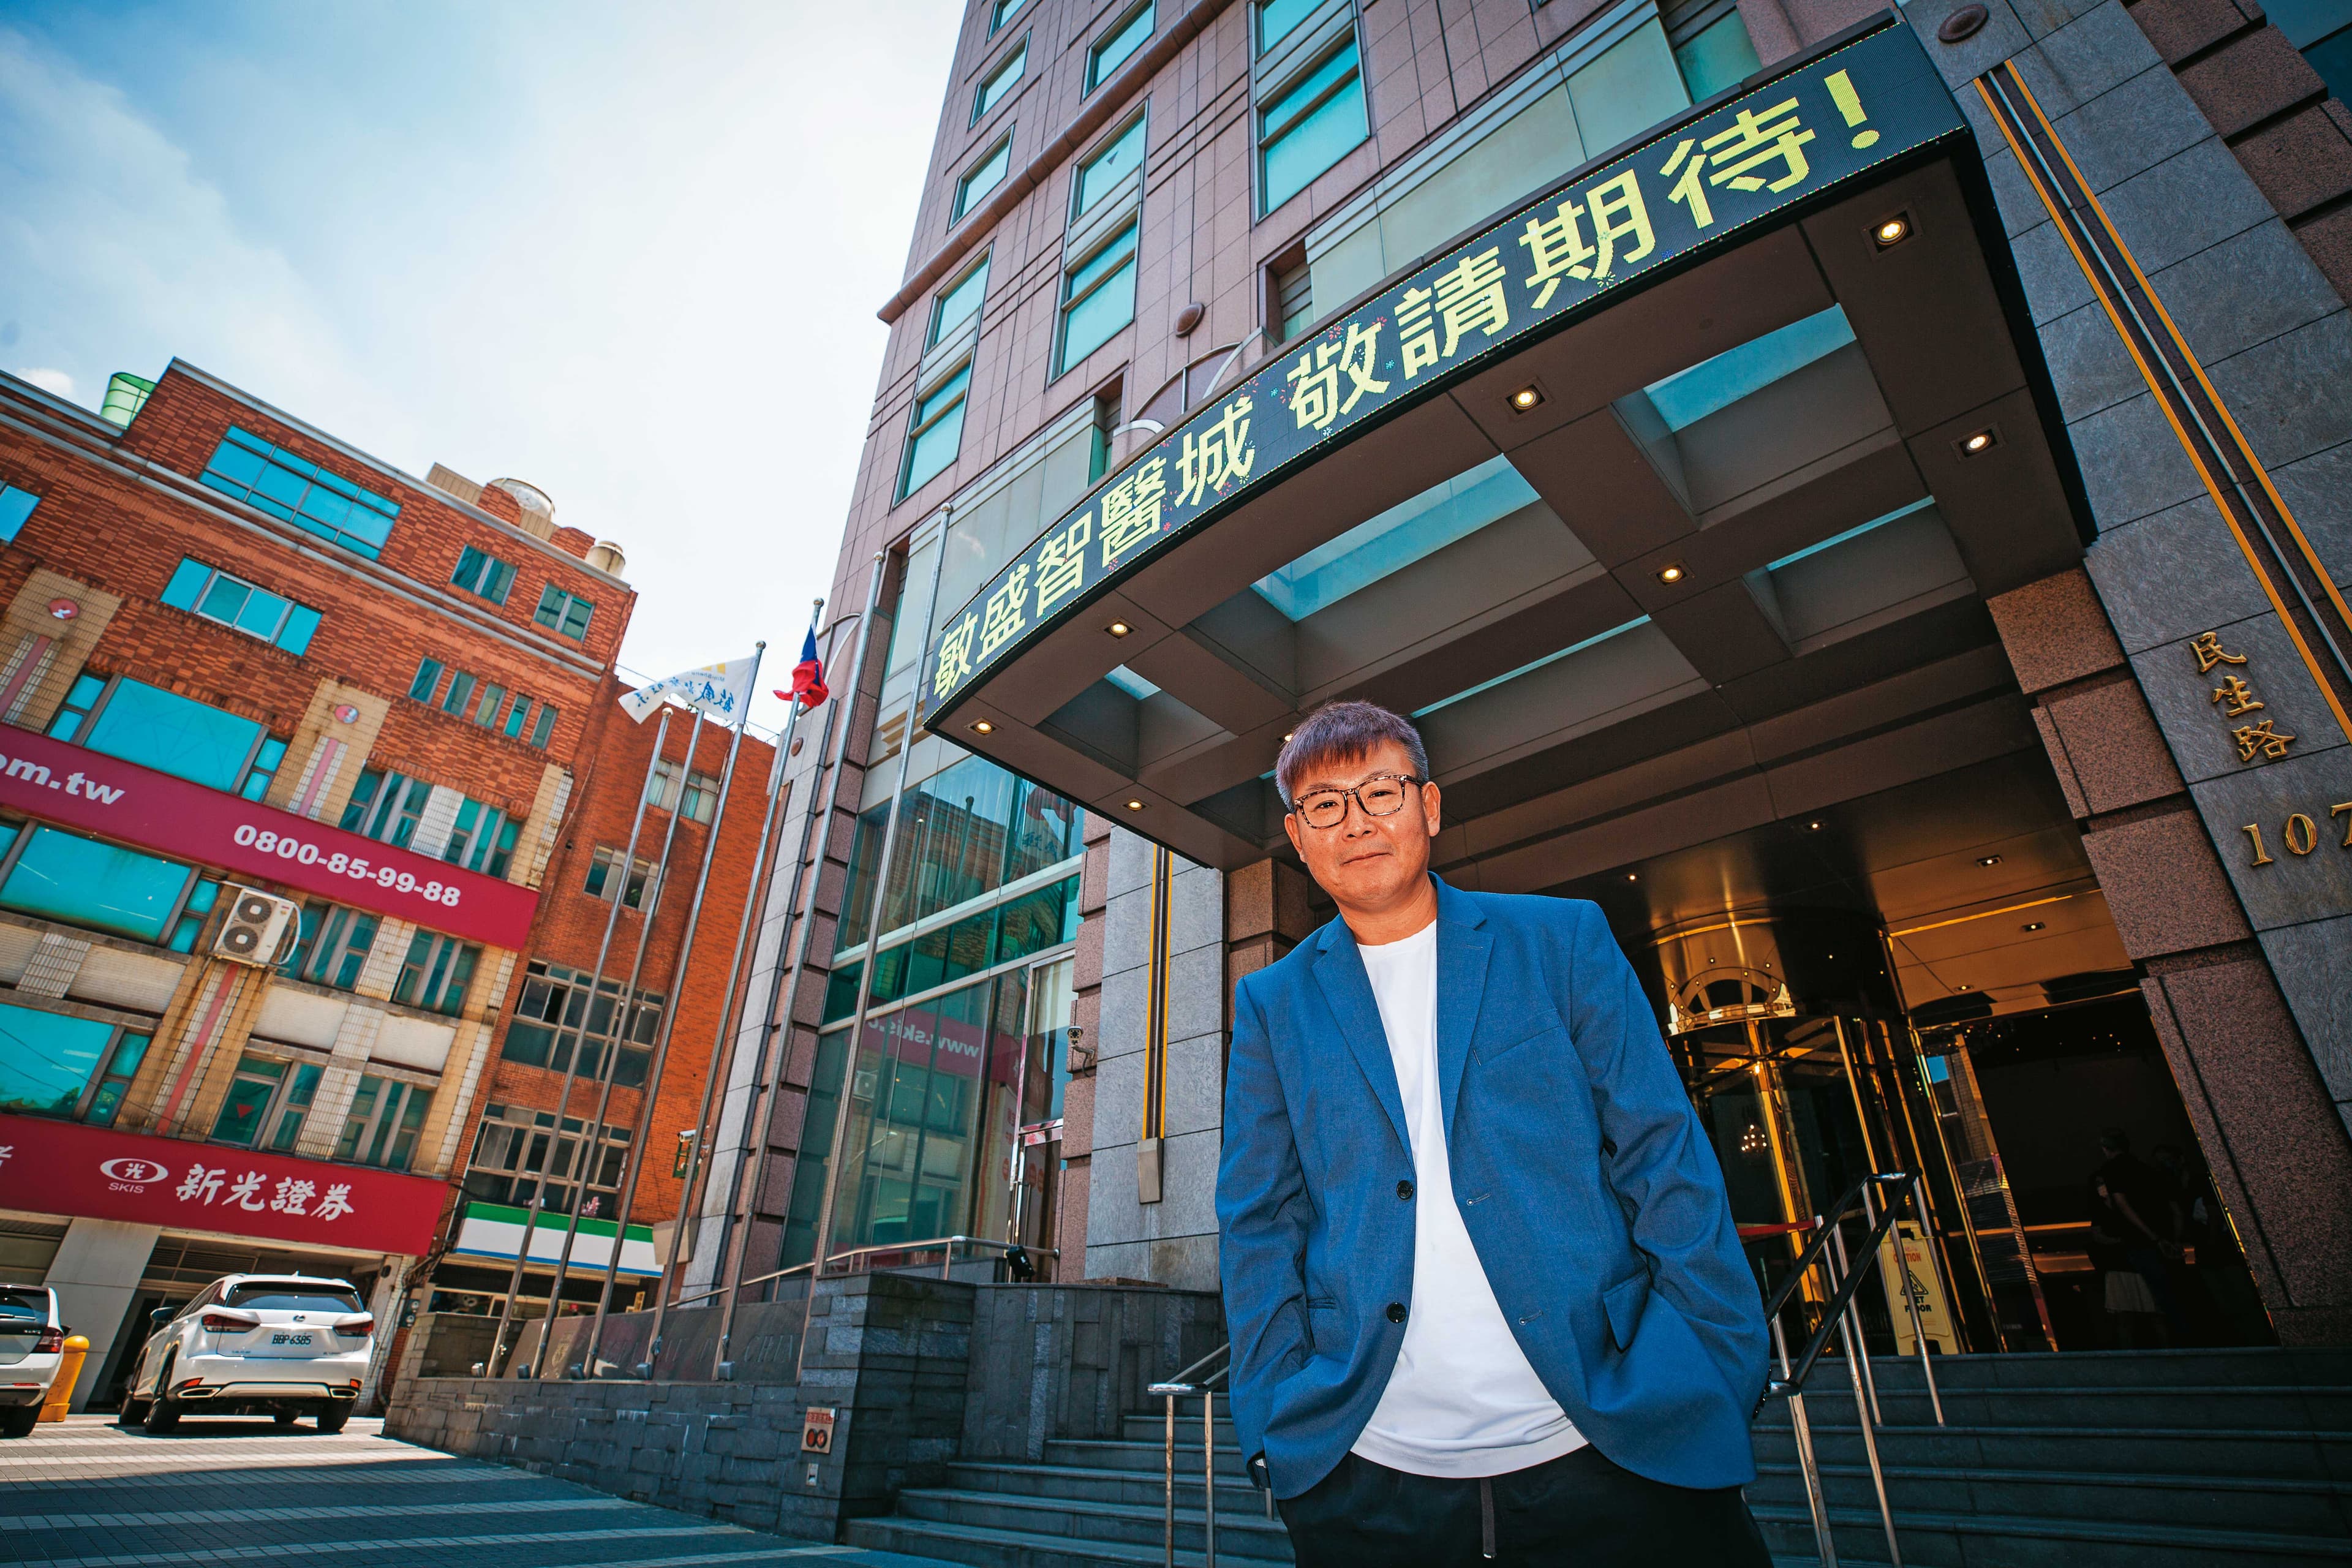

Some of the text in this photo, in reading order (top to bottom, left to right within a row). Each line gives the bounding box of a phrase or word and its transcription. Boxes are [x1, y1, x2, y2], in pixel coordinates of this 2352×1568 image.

[933, 68, 1880, 700] 敏盛智醫城 敬請期待！
[2189, 631, 2296, 763] 民生路
[2242, 801, 2352, 867] 107
[233, 823, 462, 908] 0800-85-99-88
[108, 1182, 145, 1194] SKIS
[124, 1162, 146, 1180] 光
[176, 1163, 355, 1221] 新光證券
[1893, 1253, 1921, 1262] CTION
[1905, 1304, 1932, 1313] FOOR
